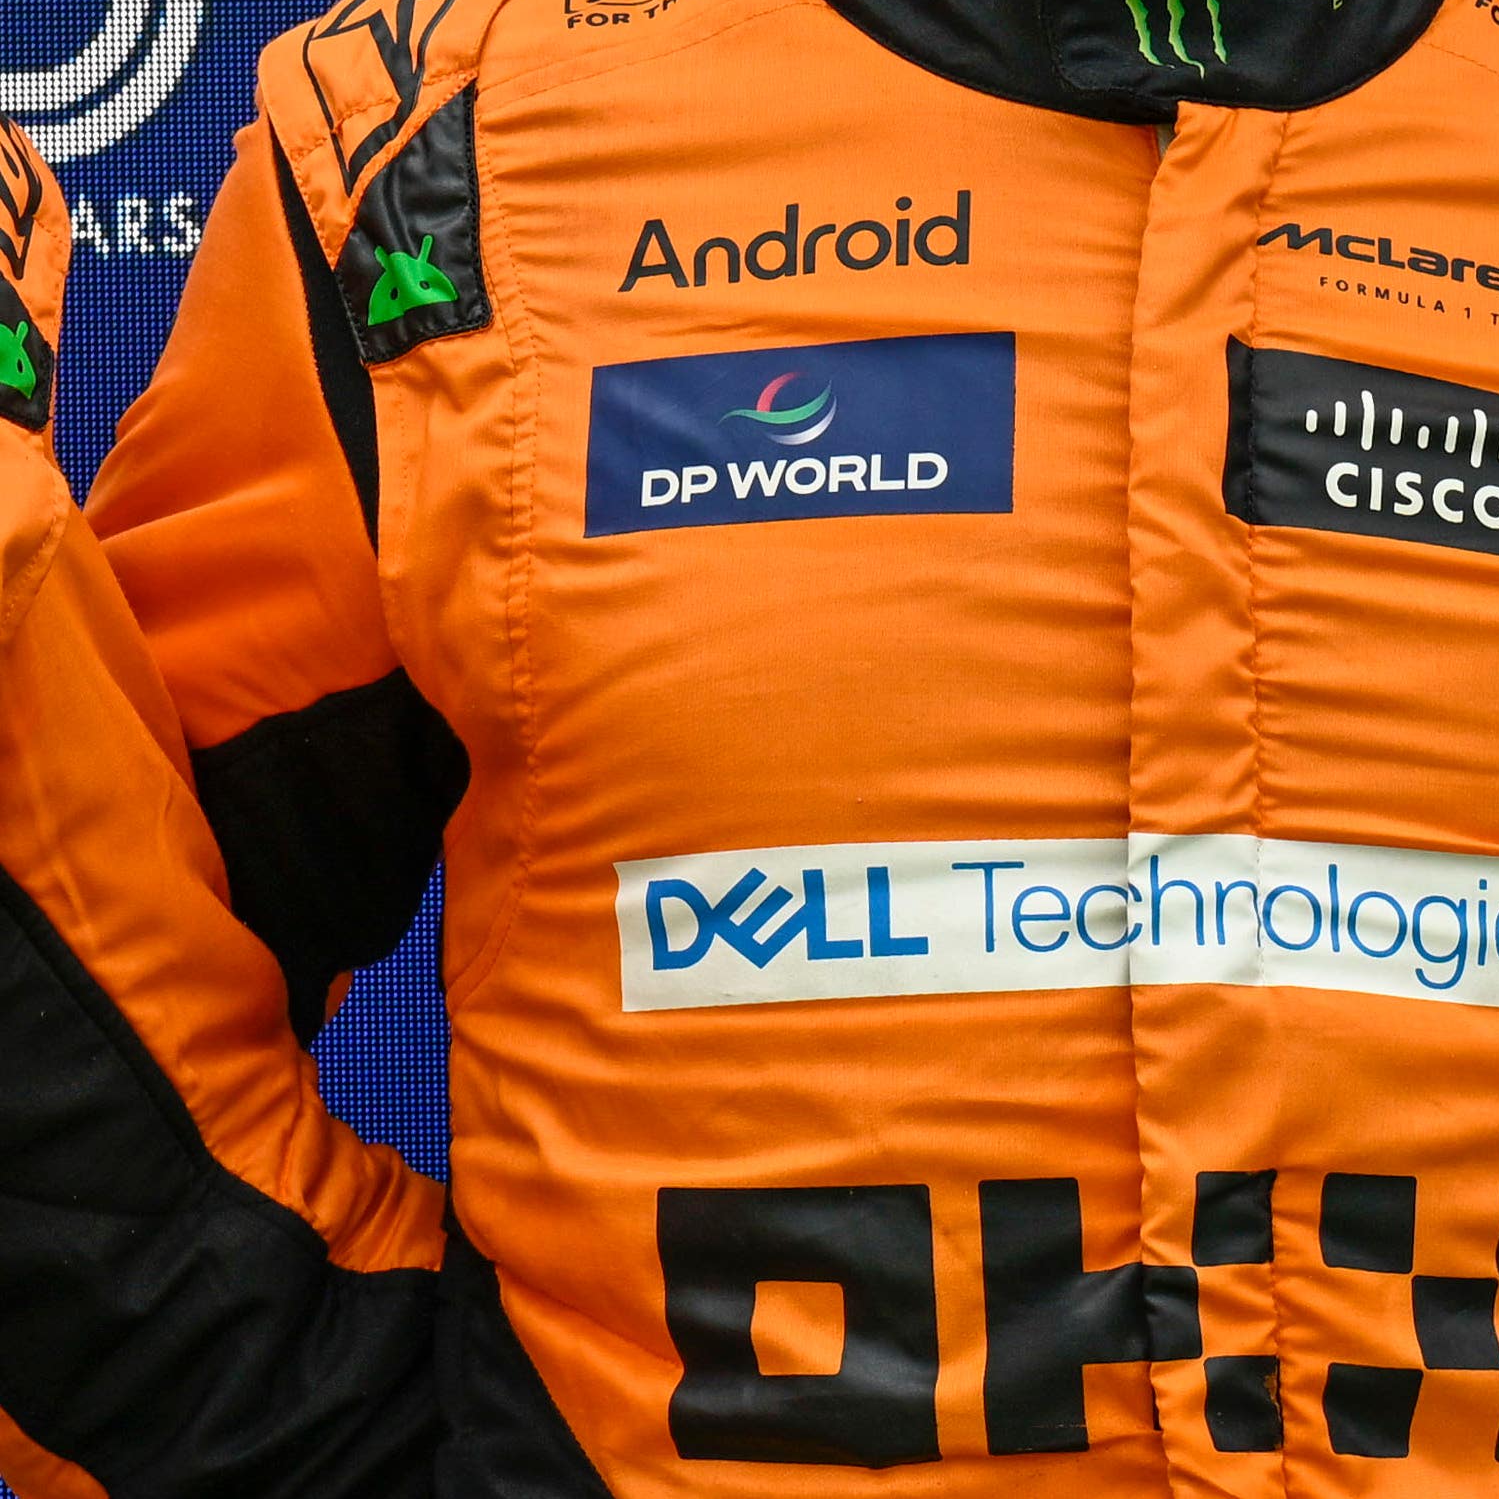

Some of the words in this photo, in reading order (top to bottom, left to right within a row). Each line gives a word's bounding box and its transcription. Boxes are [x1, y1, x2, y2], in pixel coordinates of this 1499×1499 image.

[566, 12, 631, 30] FOR
[617, 188, 972, 294] Android
[1318, 275, 1446, 314] FORMULA
[1463, 306, 1472, 320] 1
[639, 463, 718, 509] DP
[728, 451, 950, 503] WORLD
[645, 862, 930, 973] DELL
